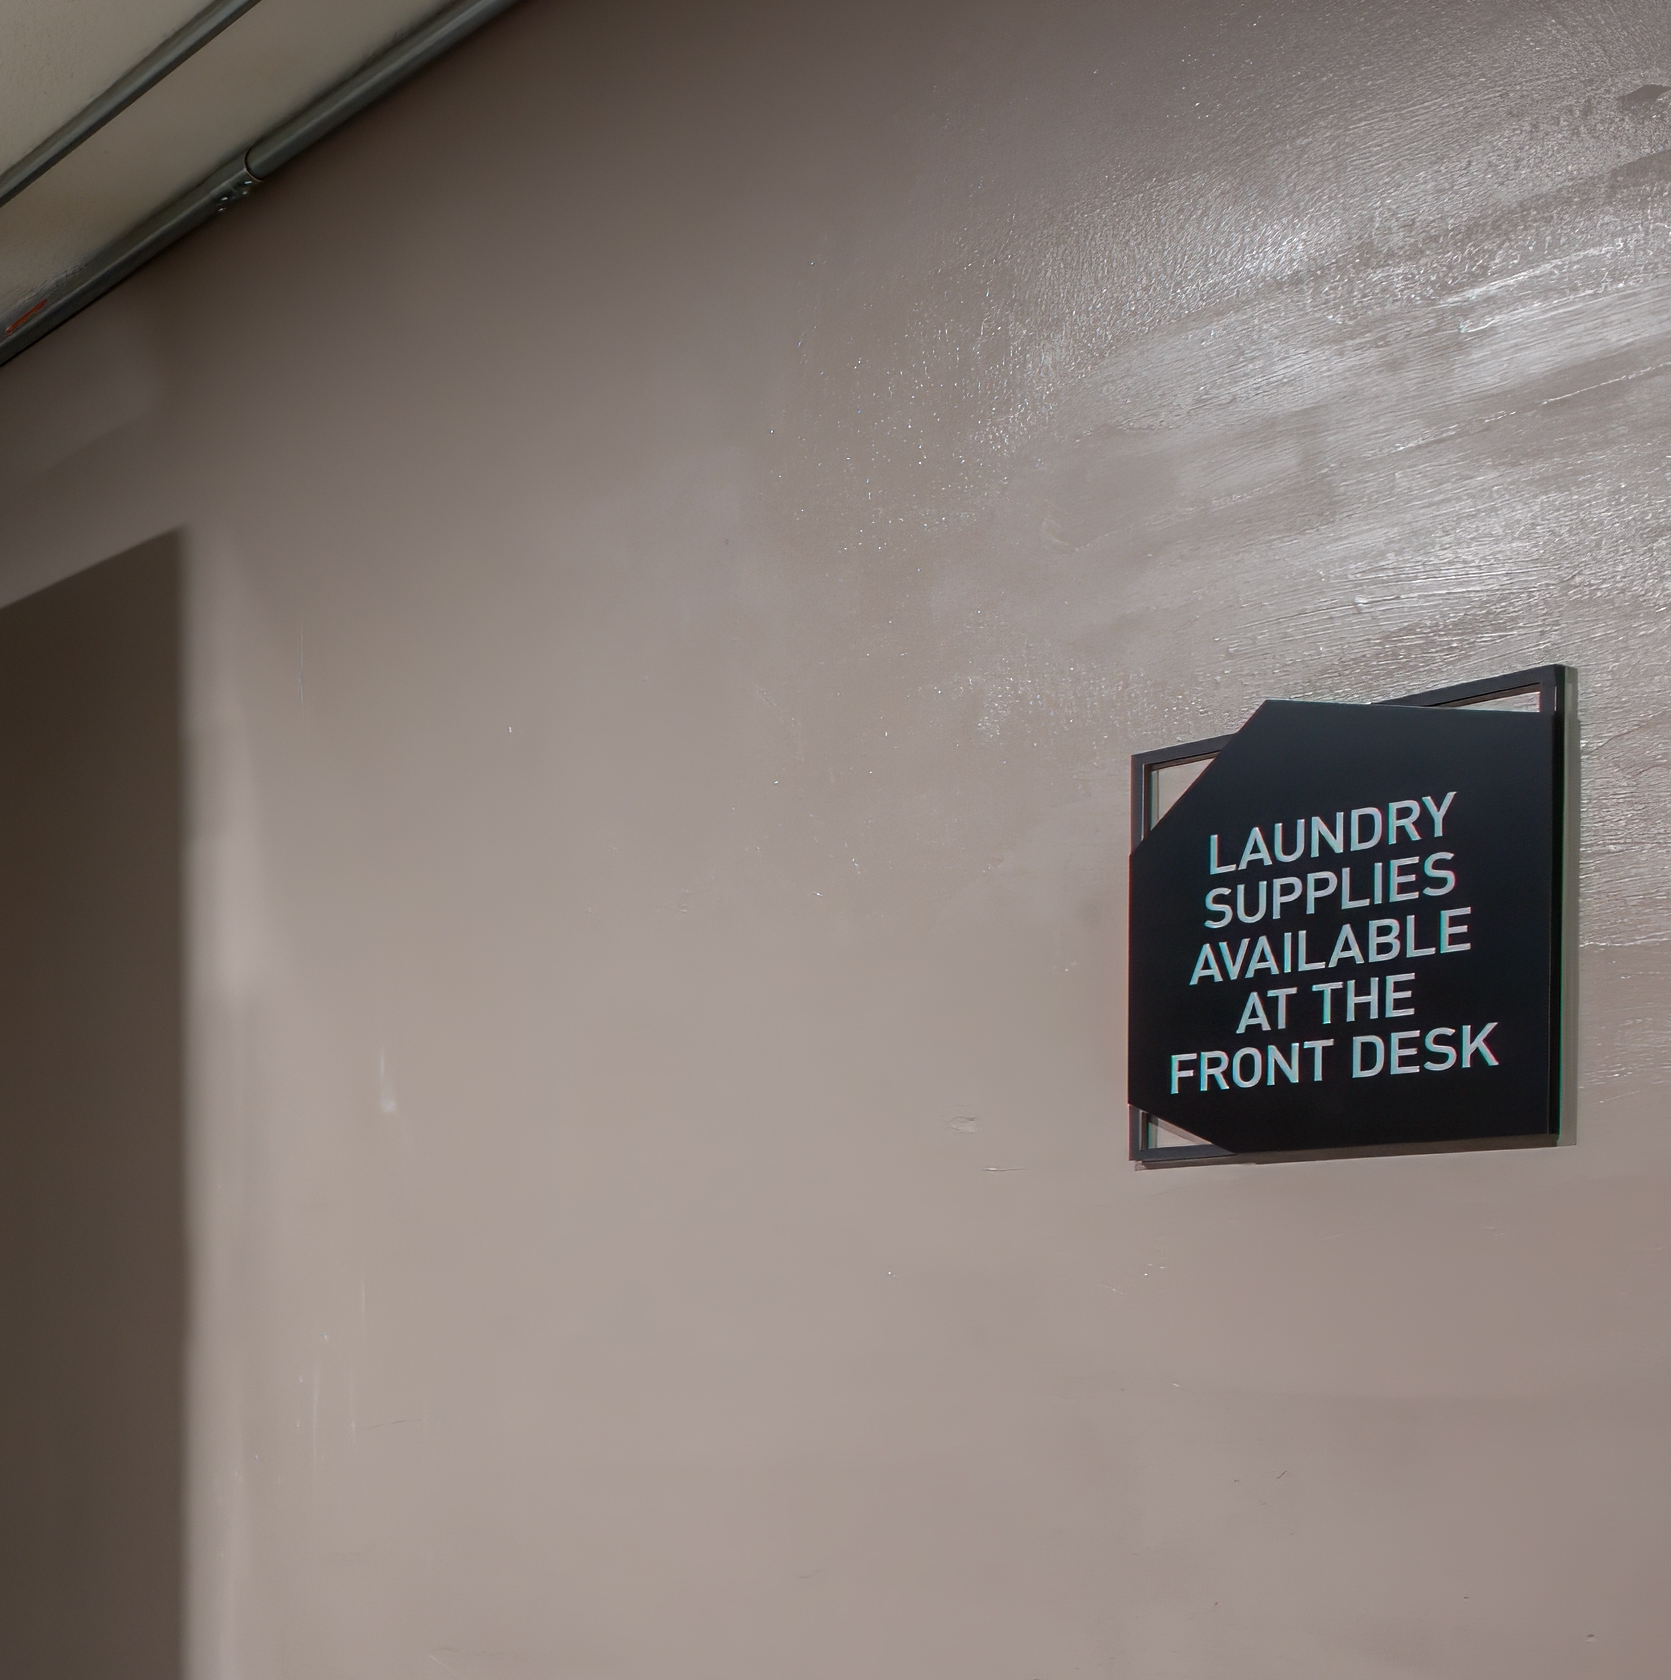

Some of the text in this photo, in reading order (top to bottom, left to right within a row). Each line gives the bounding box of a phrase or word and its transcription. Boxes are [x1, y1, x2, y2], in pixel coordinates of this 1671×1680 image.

[1209, 791, 1457, 876] LAUNDRY
[1203, 851, 1456, 930] SUPPLIES
[1189, 906, 1472, 986] AVAILABLE
[1235, 972, 1416, 1035] AT THE
[1169, 1021, 1500, 1095] FRONT DESK
